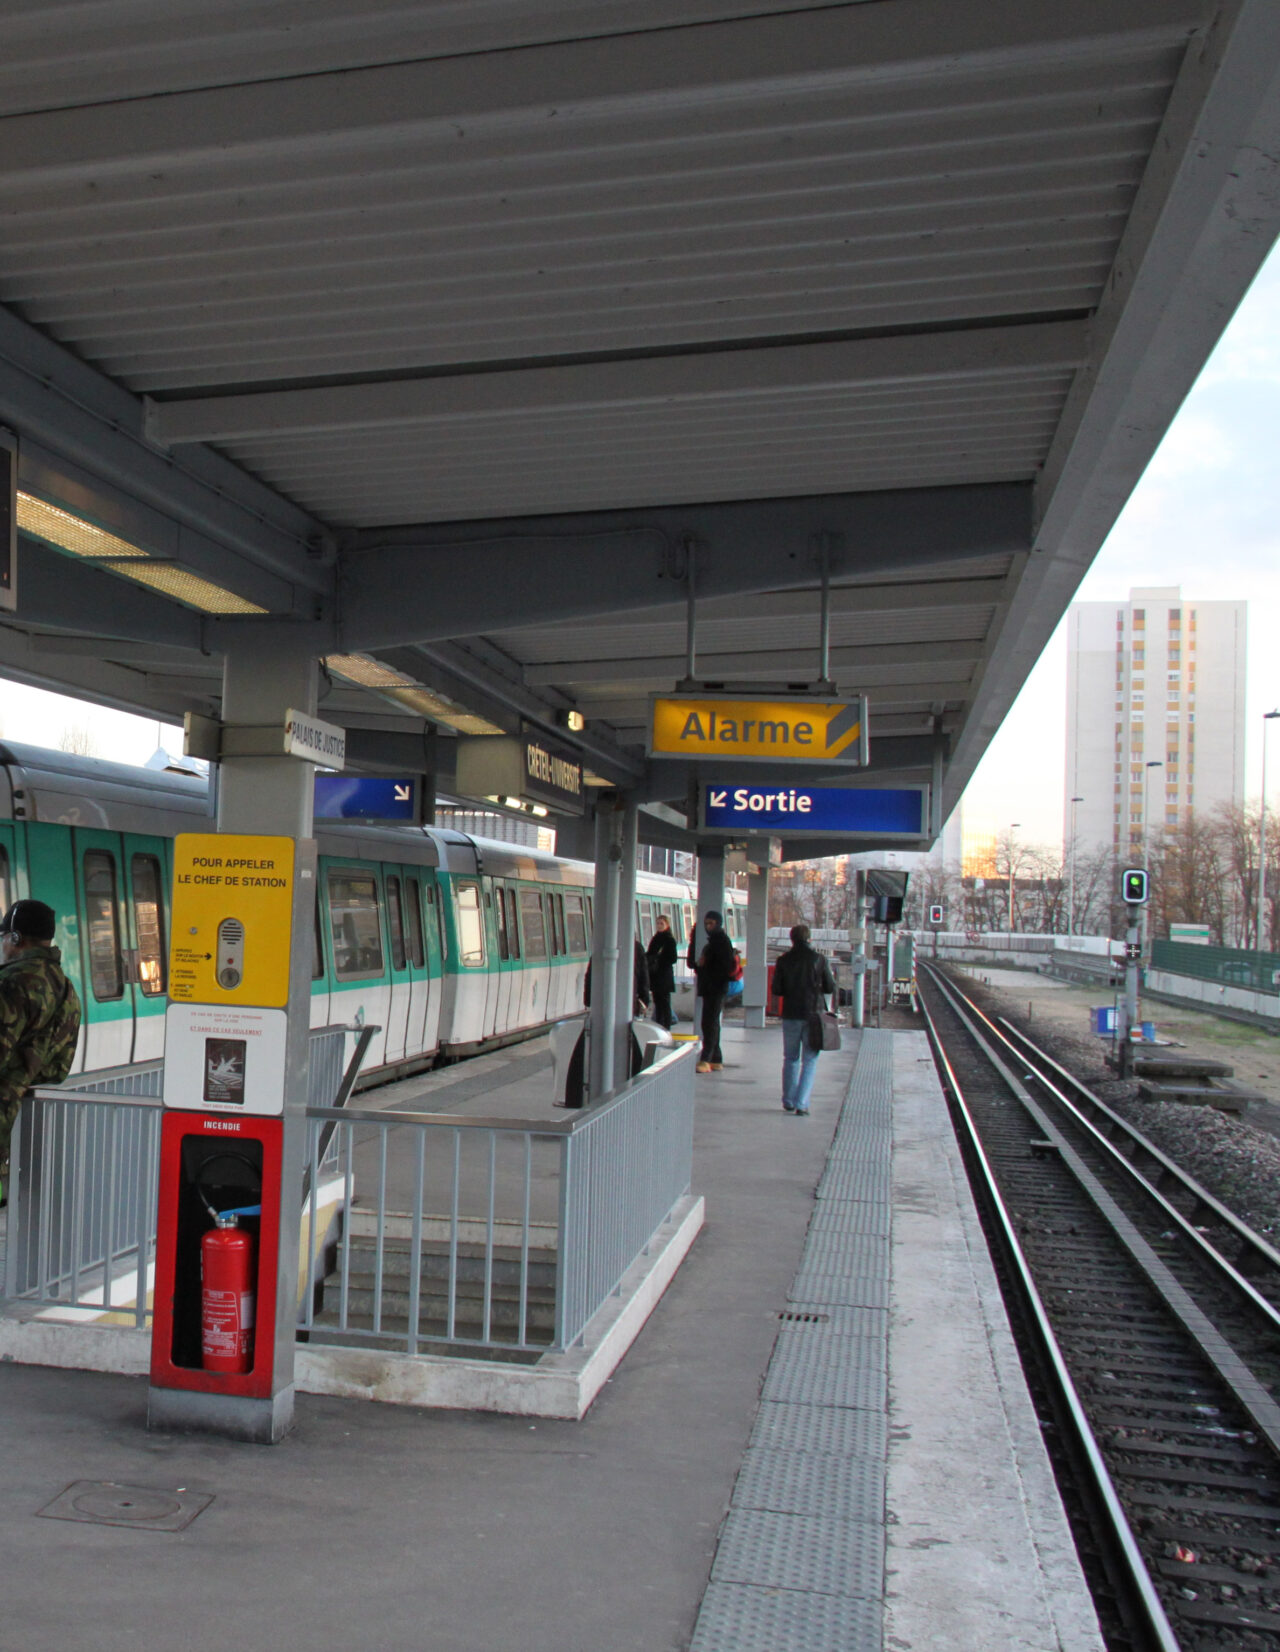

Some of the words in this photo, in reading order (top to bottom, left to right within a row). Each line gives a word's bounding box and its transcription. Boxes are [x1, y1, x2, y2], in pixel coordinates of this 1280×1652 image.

[680, 712, 813, 744] Alarme
[293, 721, 313, 748] PALAIS
[314, 729, 322, 752] DE
[323, 733, 345, 759] JUSTICE
[733, 789, 812, 813] Sortie
[192, 857, 222, 868] POUR
[225, 858, 275, 870] APPELER
[178, 874, 191, 884] LE
[194, 874, 222, 885] CHEF
[224, 876, 239, 886] DE
[242, 876, 287, 888] STATION
[893, 982, 910, 994] CM
[203, 1120, 241, 1131] INCENDIE
